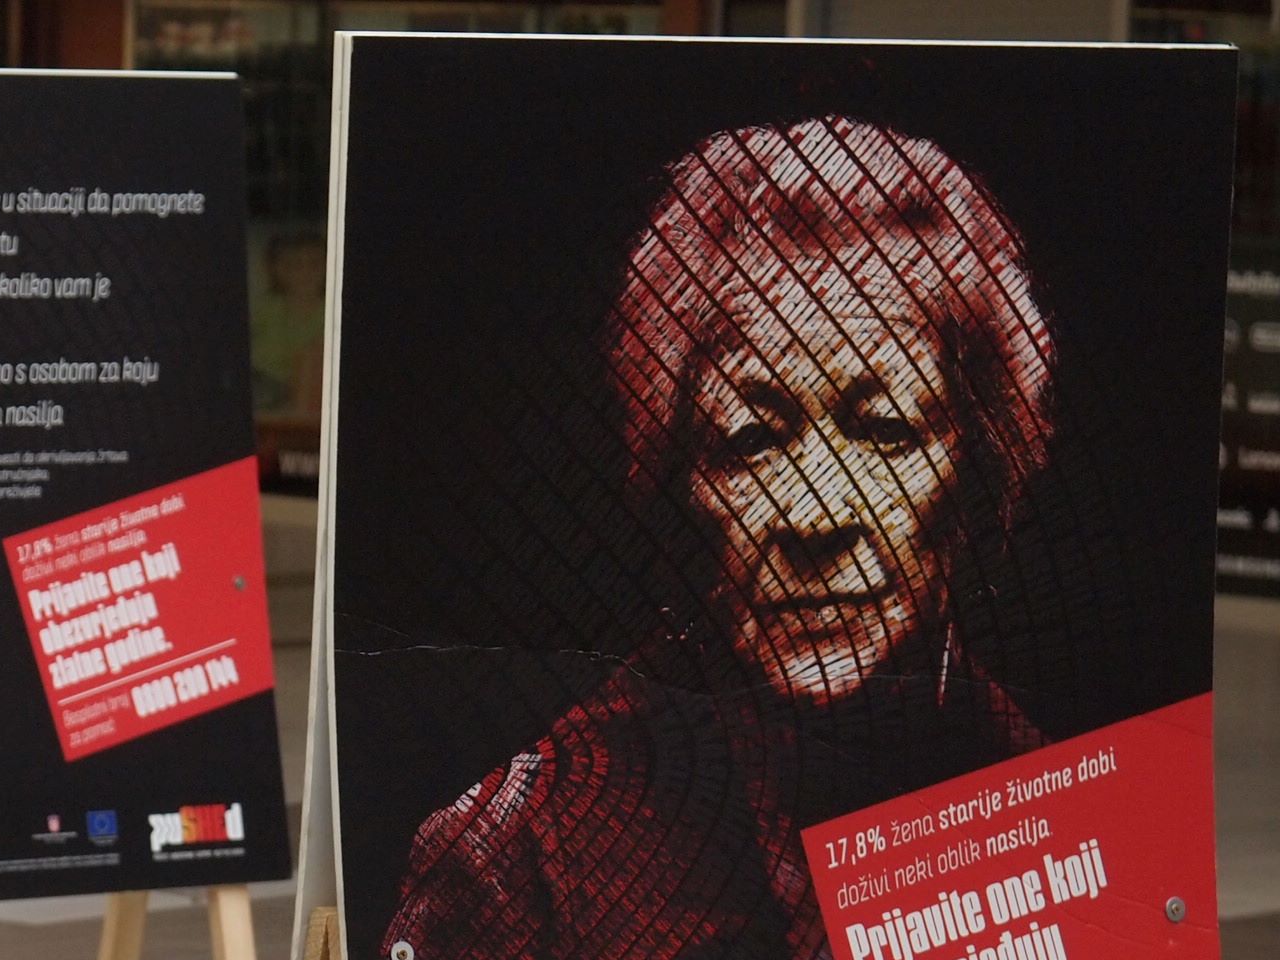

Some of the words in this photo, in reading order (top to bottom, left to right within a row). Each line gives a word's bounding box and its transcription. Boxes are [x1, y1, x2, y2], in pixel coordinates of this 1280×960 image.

[2, 193, 14, 213] u
[16, 187, 85, 217] situaciji
[87, 188, 110, 214] da
[112, 190, 205, 217] pomognete
[54, 277, 92, 298] vam
[92, 273, 111, 302] je
[15, 364, 26, 383] s
[29, 358, 96, 383] osobom
[98, 361, 119, 382] za
[122, 357, 159, 386] koju
[5, 400, 63, 430] nasilja
[826, 825, 887, 868] 17,8%
[891, 815, 935, 847] žena
[938, 791, 1003, 831] starije
[1007, 768, 1073, 808] životne
[1078, 747, 1117, 784] dobi
[837, 872, 891, 909] doživi
[894, 855, 934, 889] neki
[937, 838, 981, 874] oblik
[985, 868, 1046, 924] one
[1043, 839, 1108, 904] koji
